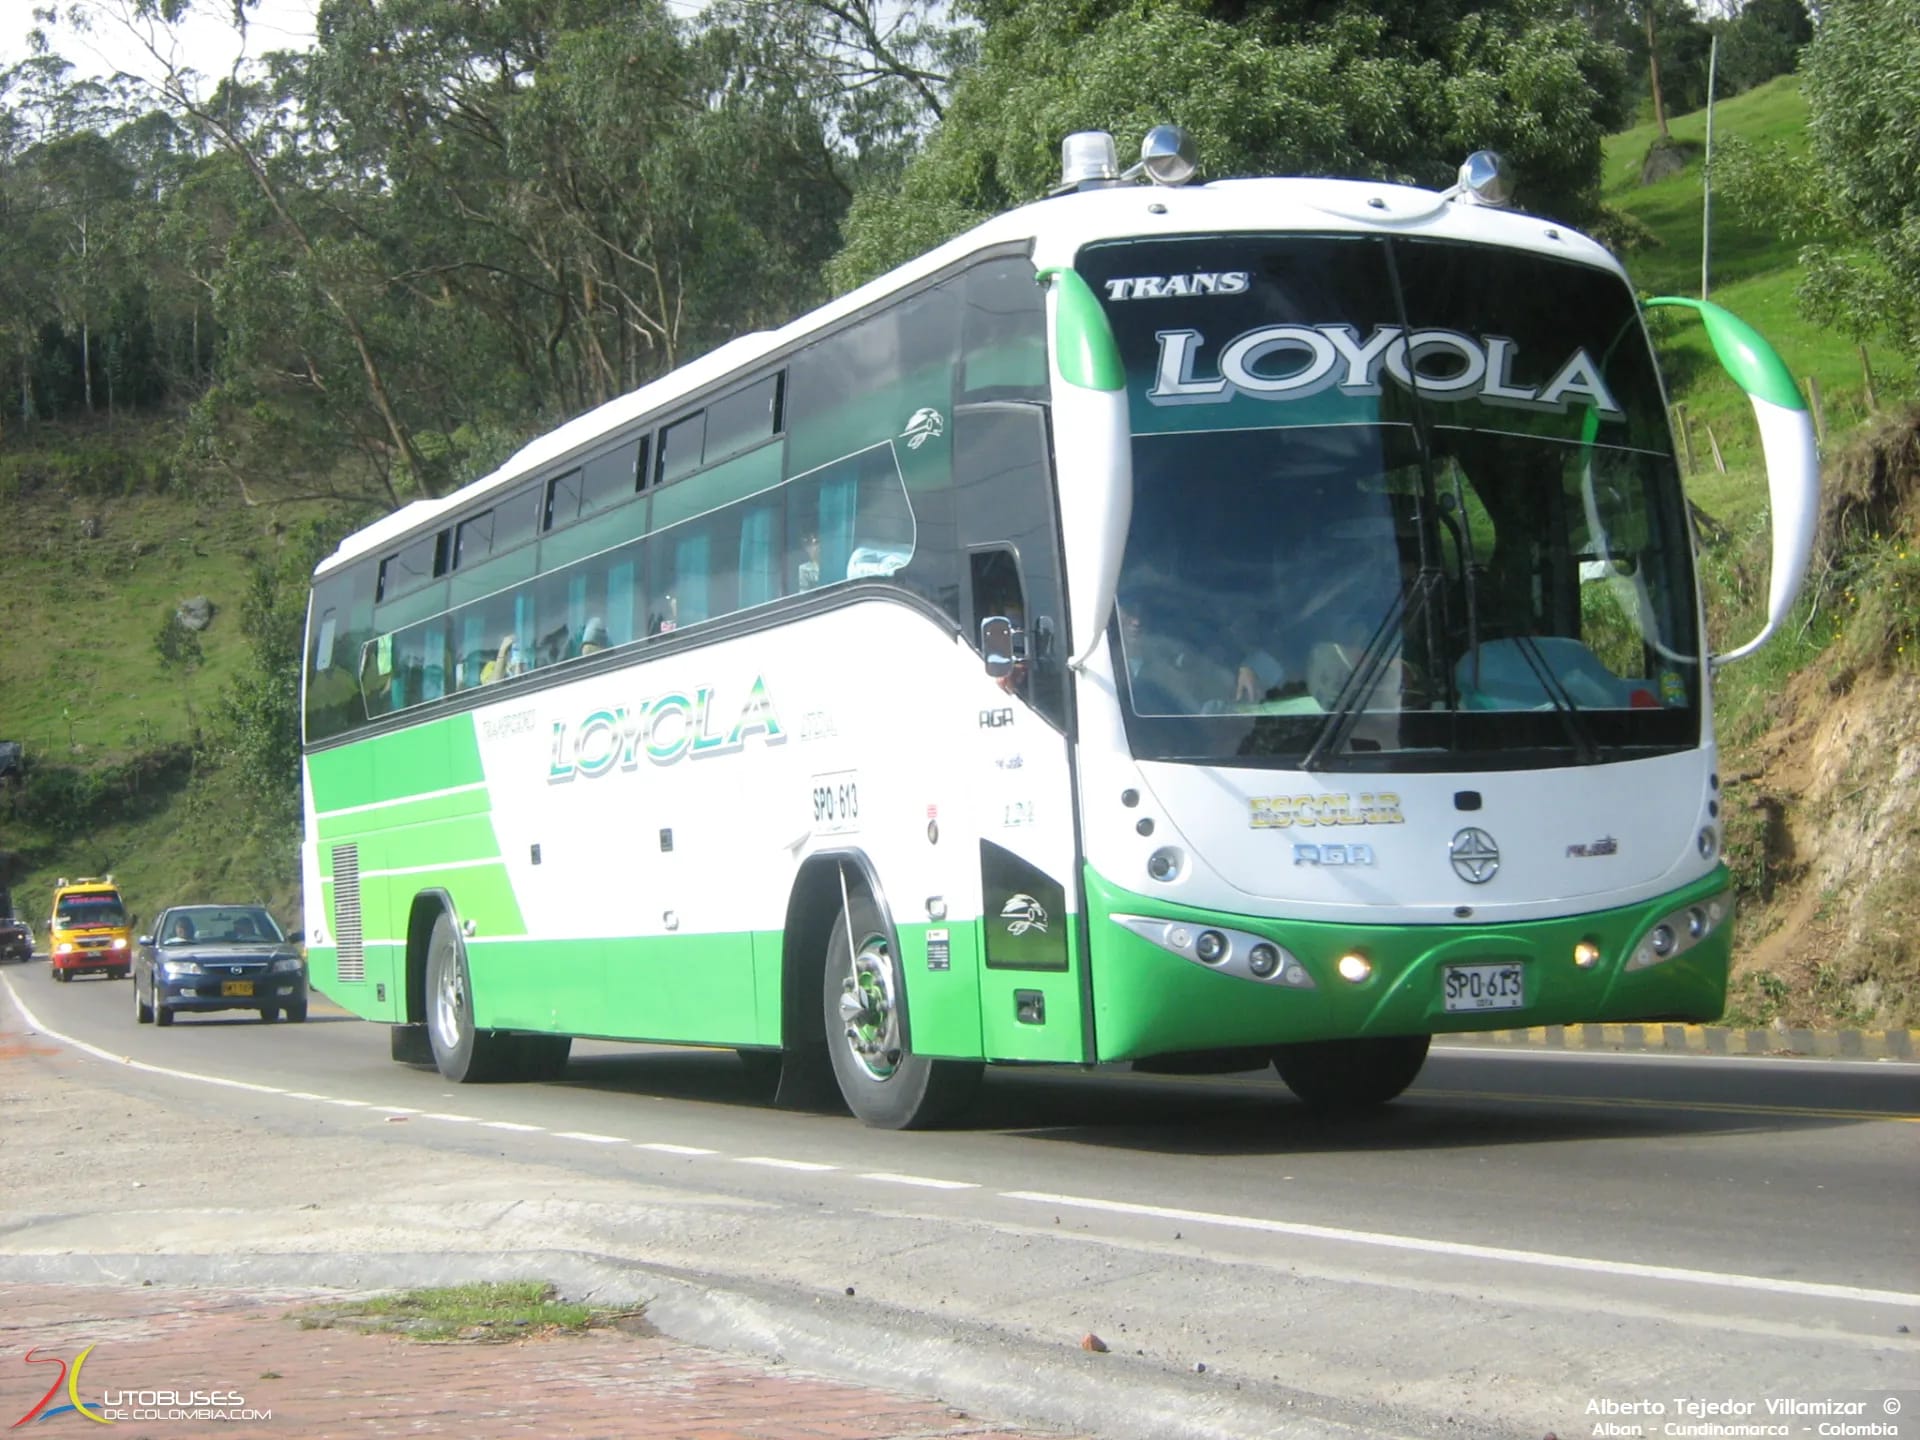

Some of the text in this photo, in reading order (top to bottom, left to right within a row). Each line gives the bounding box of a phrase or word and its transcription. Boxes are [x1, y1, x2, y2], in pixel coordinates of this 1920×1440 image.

[1105, 271, 1249, 299] TRANS
[1146, 323, 1626, 420] LOYOLA
[547, 673, 787, 785] LOYOLA
[979, 707, 1014, 728] AGA
[1248, 792, 1405, 829] ESCOLAR
[1292, 843, 1375, 866] AGA
